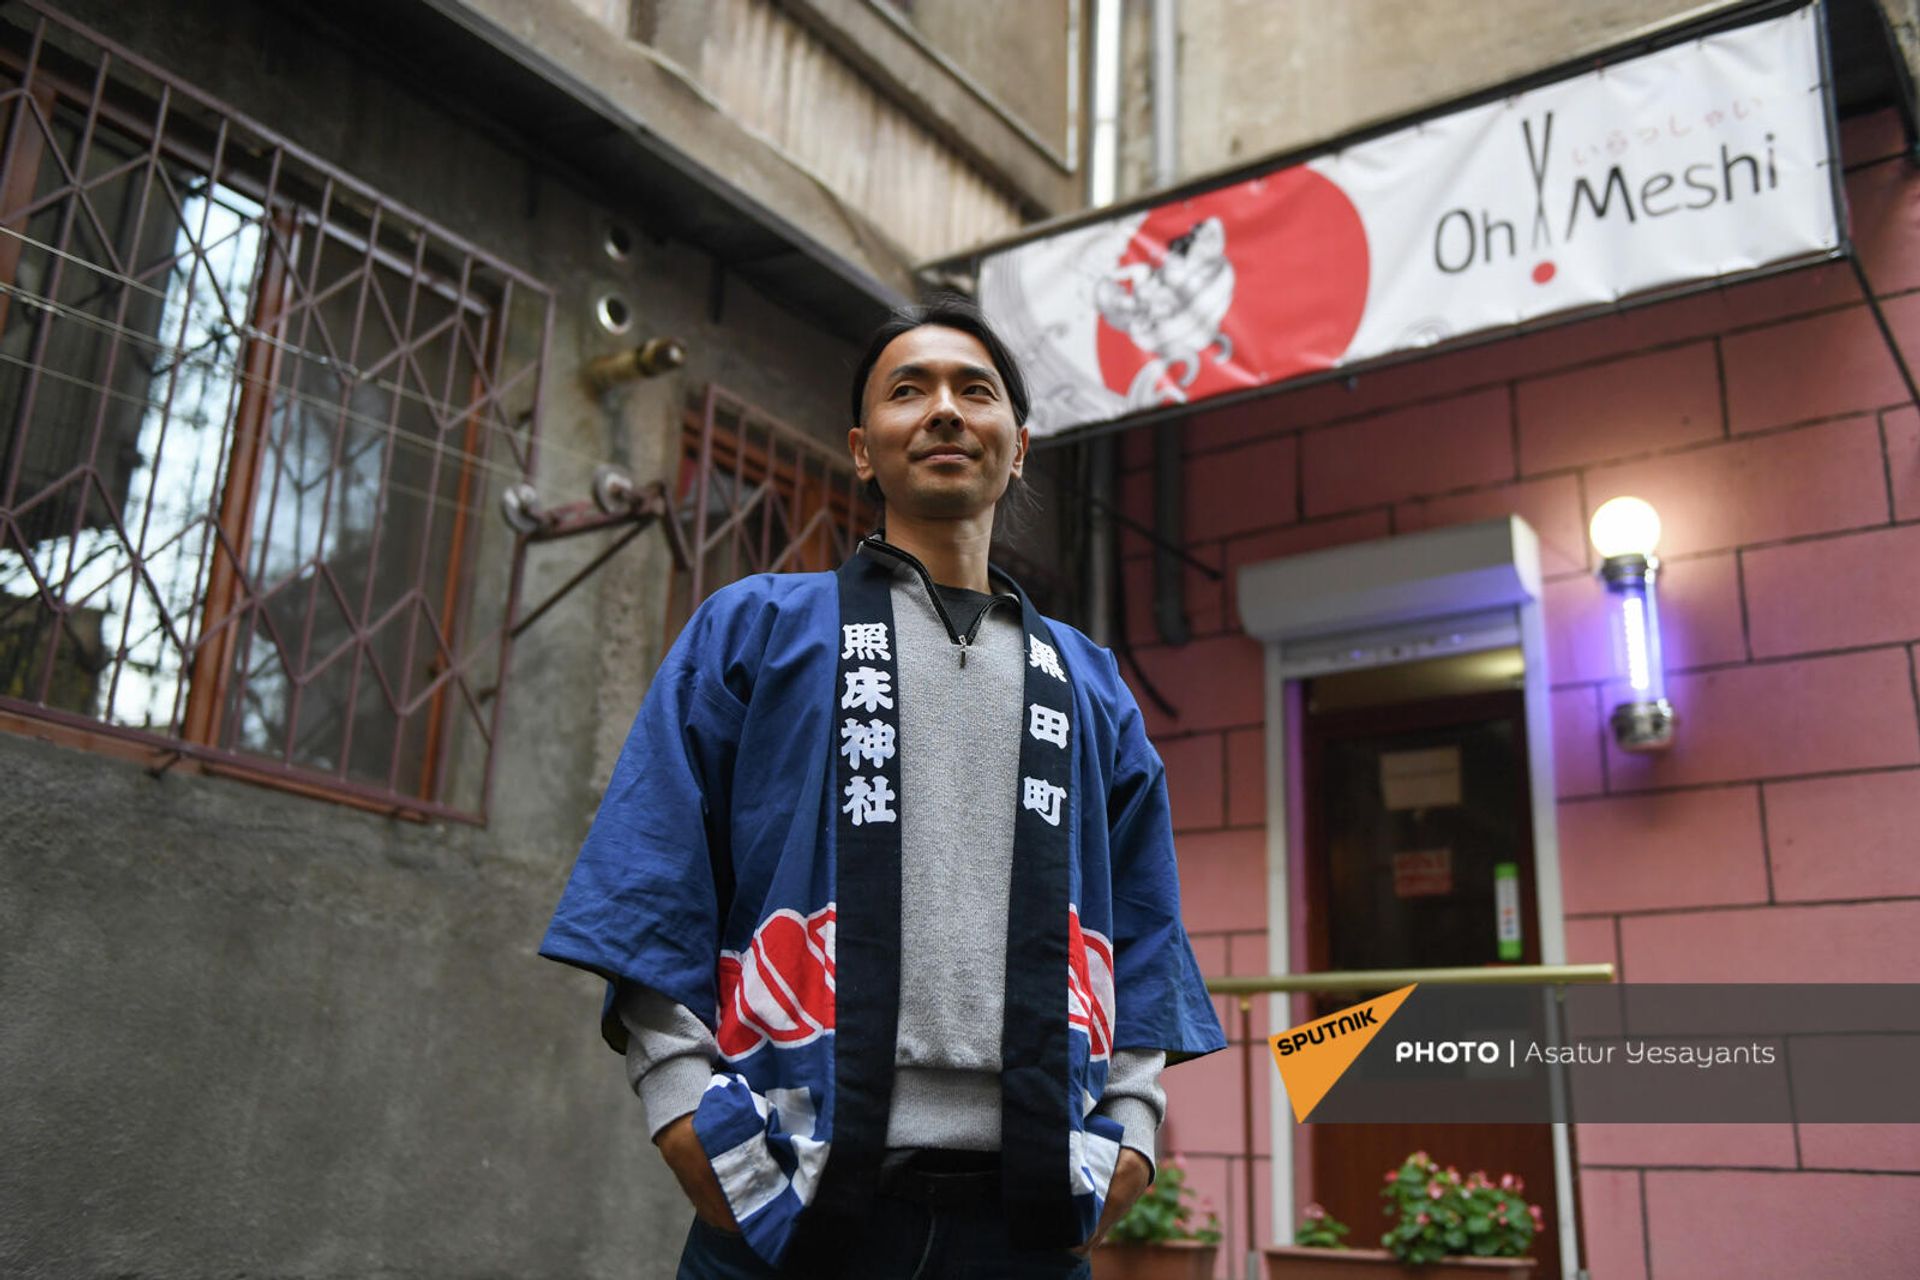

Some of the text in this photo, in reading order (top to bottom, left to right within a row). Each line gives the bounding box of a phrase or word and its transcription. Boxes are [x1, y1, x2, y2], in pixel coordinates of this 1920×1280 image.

[1565, 132, 1778, 243] Meshi
[841, 622, 897, 826] 照床神社
